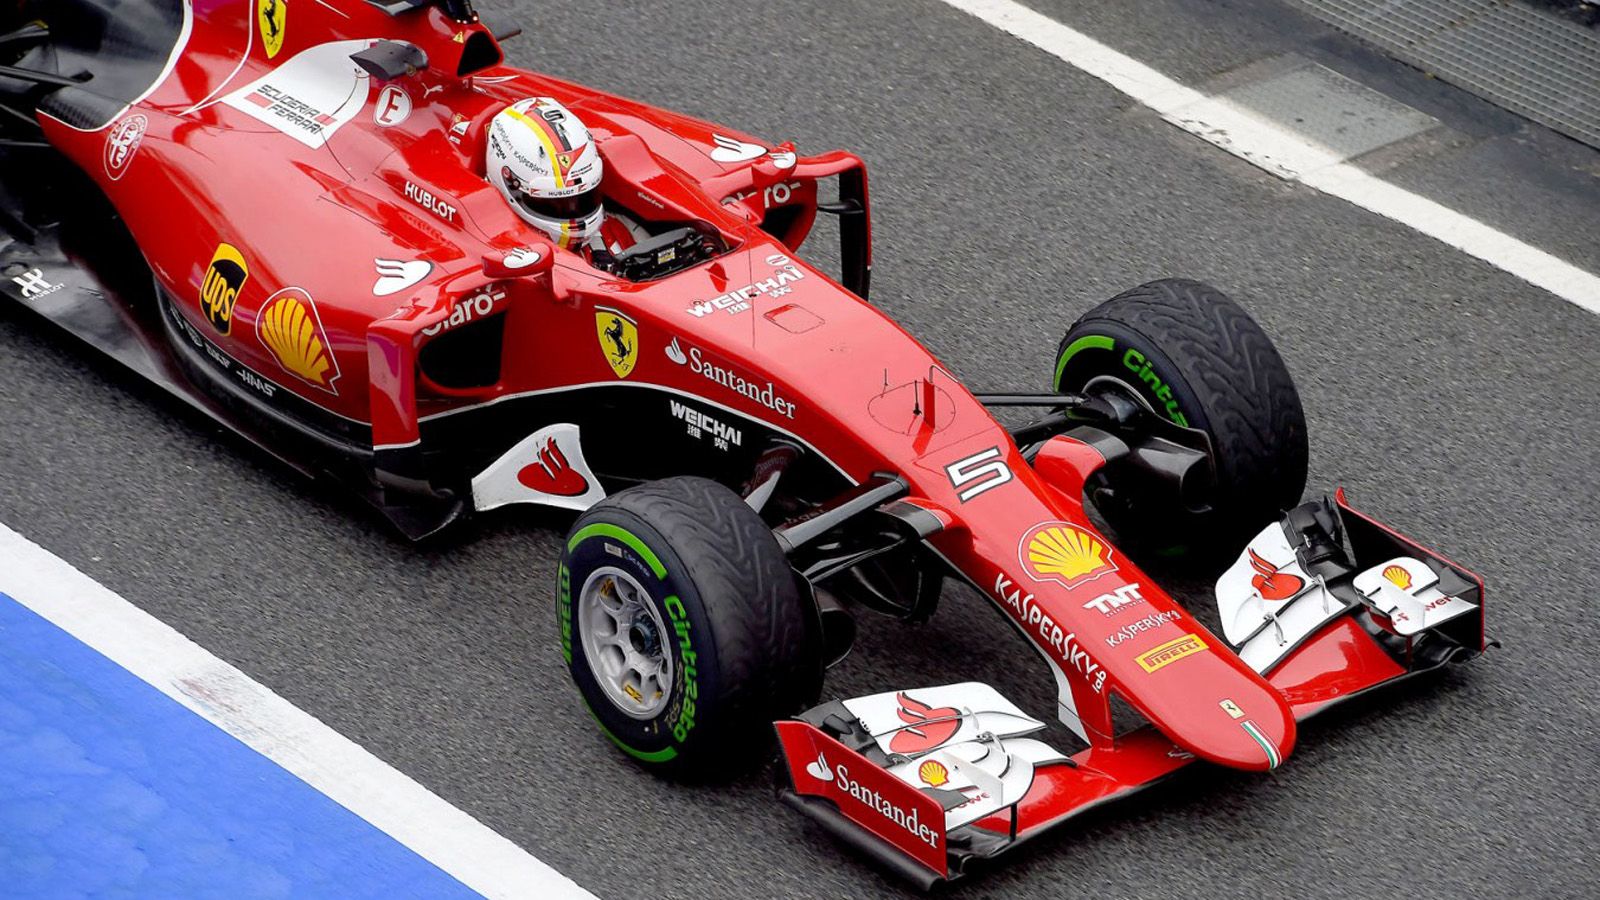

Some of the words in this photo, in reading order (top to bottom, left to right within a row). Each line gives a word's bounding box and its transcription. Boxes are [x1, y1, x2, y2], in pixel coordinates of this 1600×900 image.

[257, 83, 321, 119] SCUDERIA
[268, 103, 325, 135] FERRARI
[404, 180, 457, 223] HUBLOT
[29, 283, 65, 301] HUBLOT
[686, 265, 805, 318] WEICHAI
[689, 347, 796, 420] Santander
[670, 399, 742, 447] WEICHAI
[944, 445, 1014, 505] 5
[1082, 583, 1140, 615] TNT
[995, 573, 1099, 681] KASPERSKY
[1105, 610, 1174, 648] KASPERSKY
[1143, 637, 1201, 668] PIRELLI
[836, 764, 939, 849] Santander
